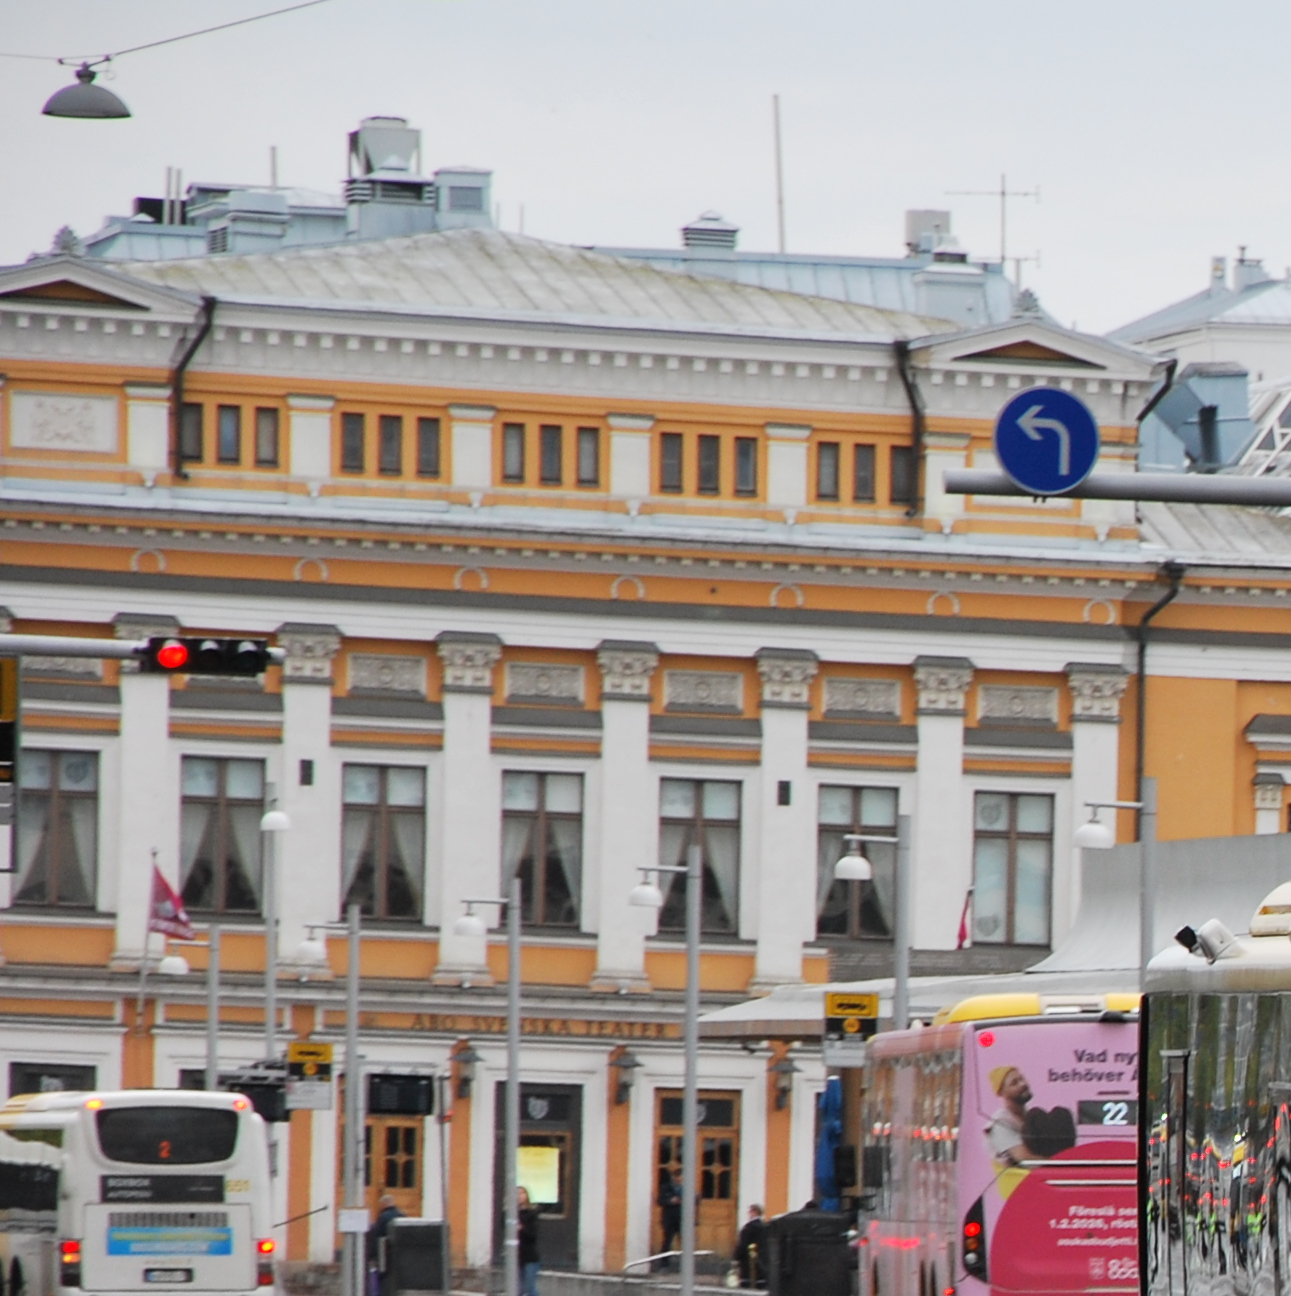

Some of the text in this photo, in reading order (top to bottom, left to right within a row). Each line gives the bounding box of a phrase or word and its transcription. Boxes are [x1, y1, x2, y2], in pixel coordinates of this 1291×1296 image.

[1074, 1049, 1107, 1063] Vad
[1048, 1068, 1125, 1082] behöver
[1102, 1102, 1128, 1126] 22
[159, 1140, 172, 1159] 2
